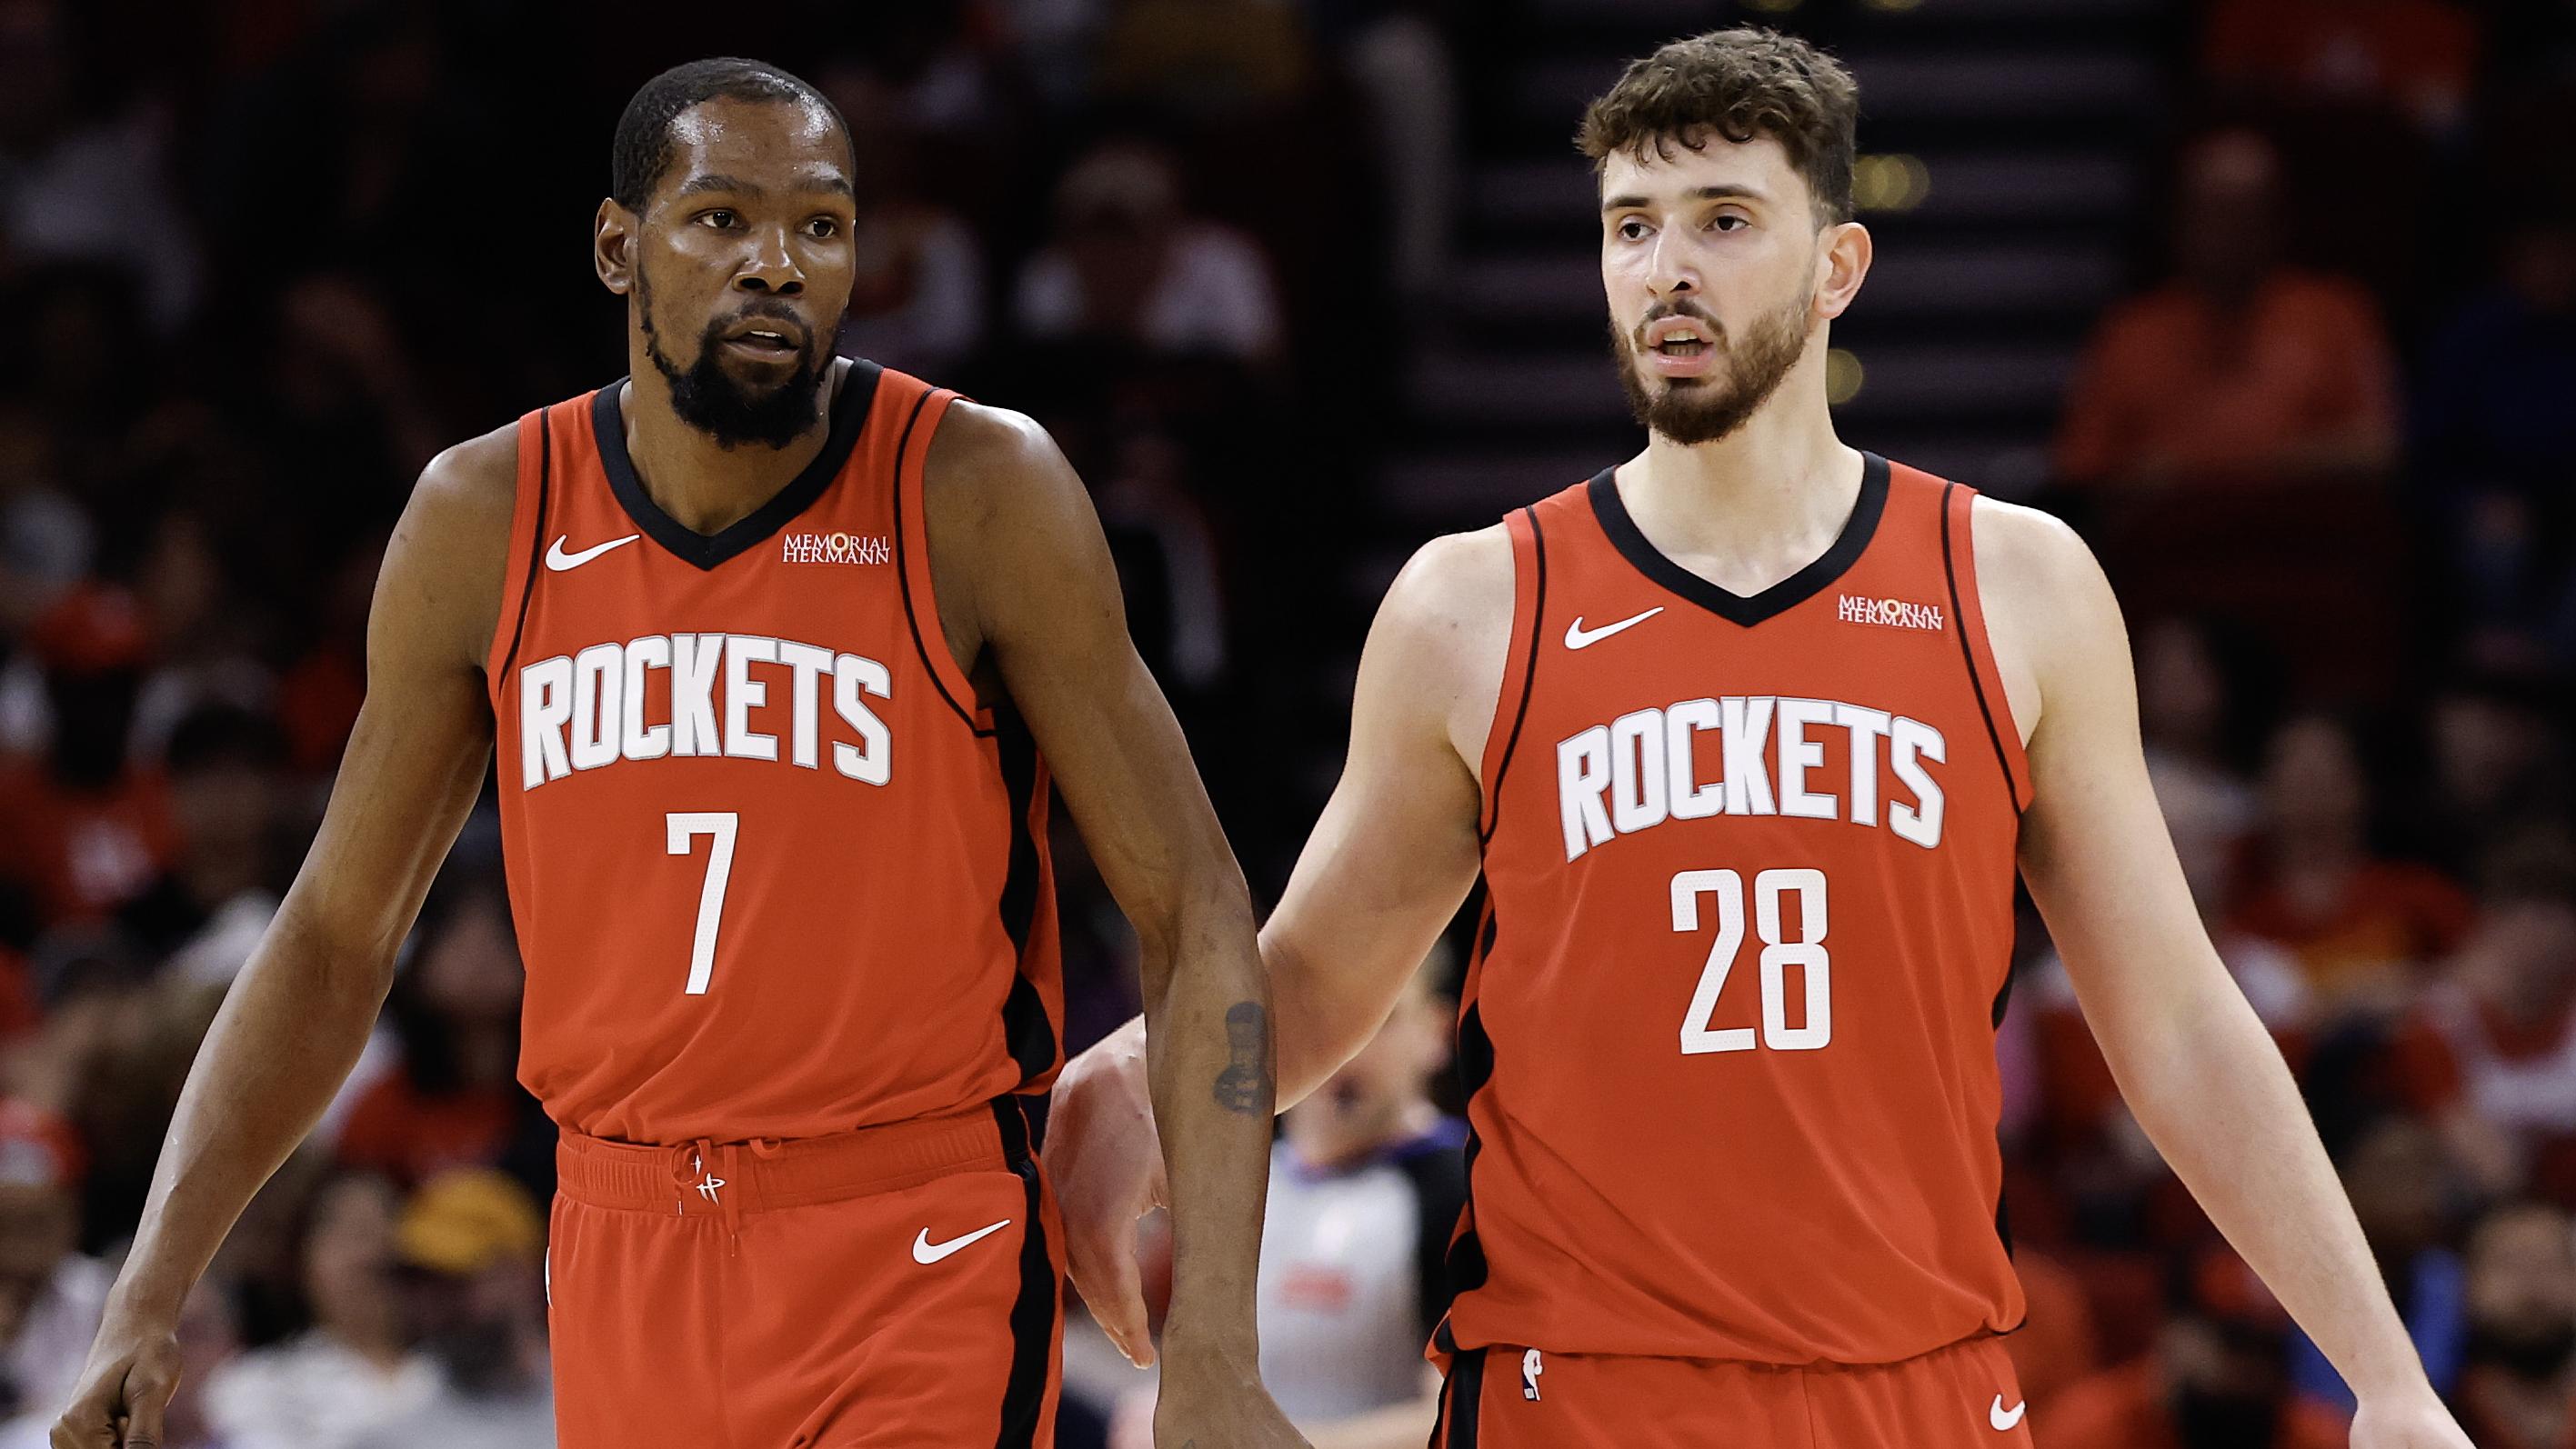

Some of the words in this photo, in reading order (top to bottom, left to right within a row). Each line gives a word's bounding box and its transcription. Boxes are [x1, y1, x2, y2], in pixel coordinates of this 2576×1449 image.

[783, 546, 890, 565] HERMANN
[784, 532, 890, 552] MEMORIAL
[1839, 594, 1943, 620] MEMORIAL
[1839, 605, 1943, 630] HERMANN
[520, 632, 891, 791] ROCKETS
[1557, 695, 1946, 863] ROCKETS
[666, 812, 738, 994] 7
[1670, 868, 1831, 1054] 28
